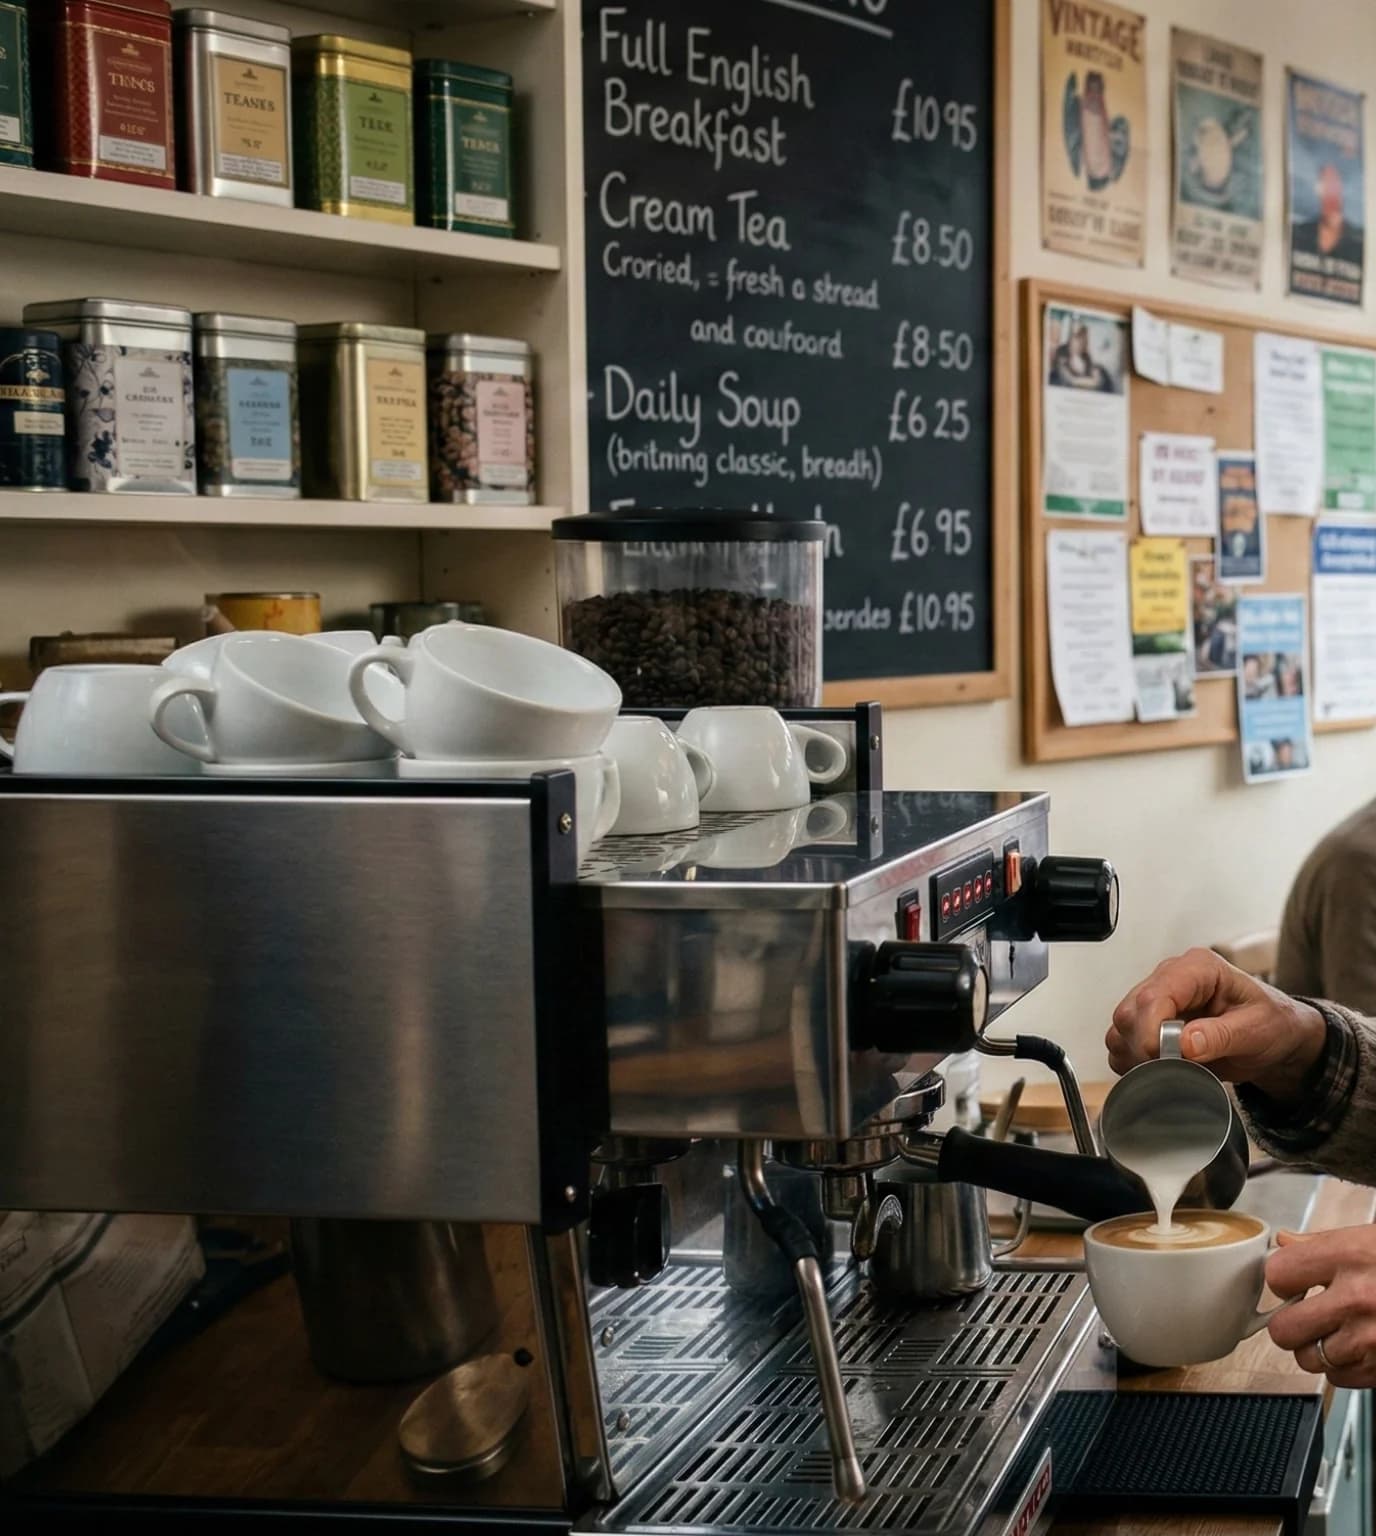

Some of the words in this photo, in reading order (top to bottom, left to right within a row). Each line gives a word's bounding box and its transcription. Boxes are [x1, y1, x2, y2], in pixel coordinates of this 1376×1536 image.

[600, 7, 673, 76] Full
[687, 27, 815, 116] English
[1049, 0, 1145, 64] VINTAGE
[604, 77, 788, 171] Breakfast
[599, 171, 717, 242] Cream
[728, 190, 791, 251] Tea
[892, 210, 974, 271] £8.50
[726, 258, 785, 300] fresh
[690, 315, 736, 346] and
[604, 365, 702, 449] Daily
[717, 370, 801, 446] Soup
[716, 443, 797, 482] classic,
